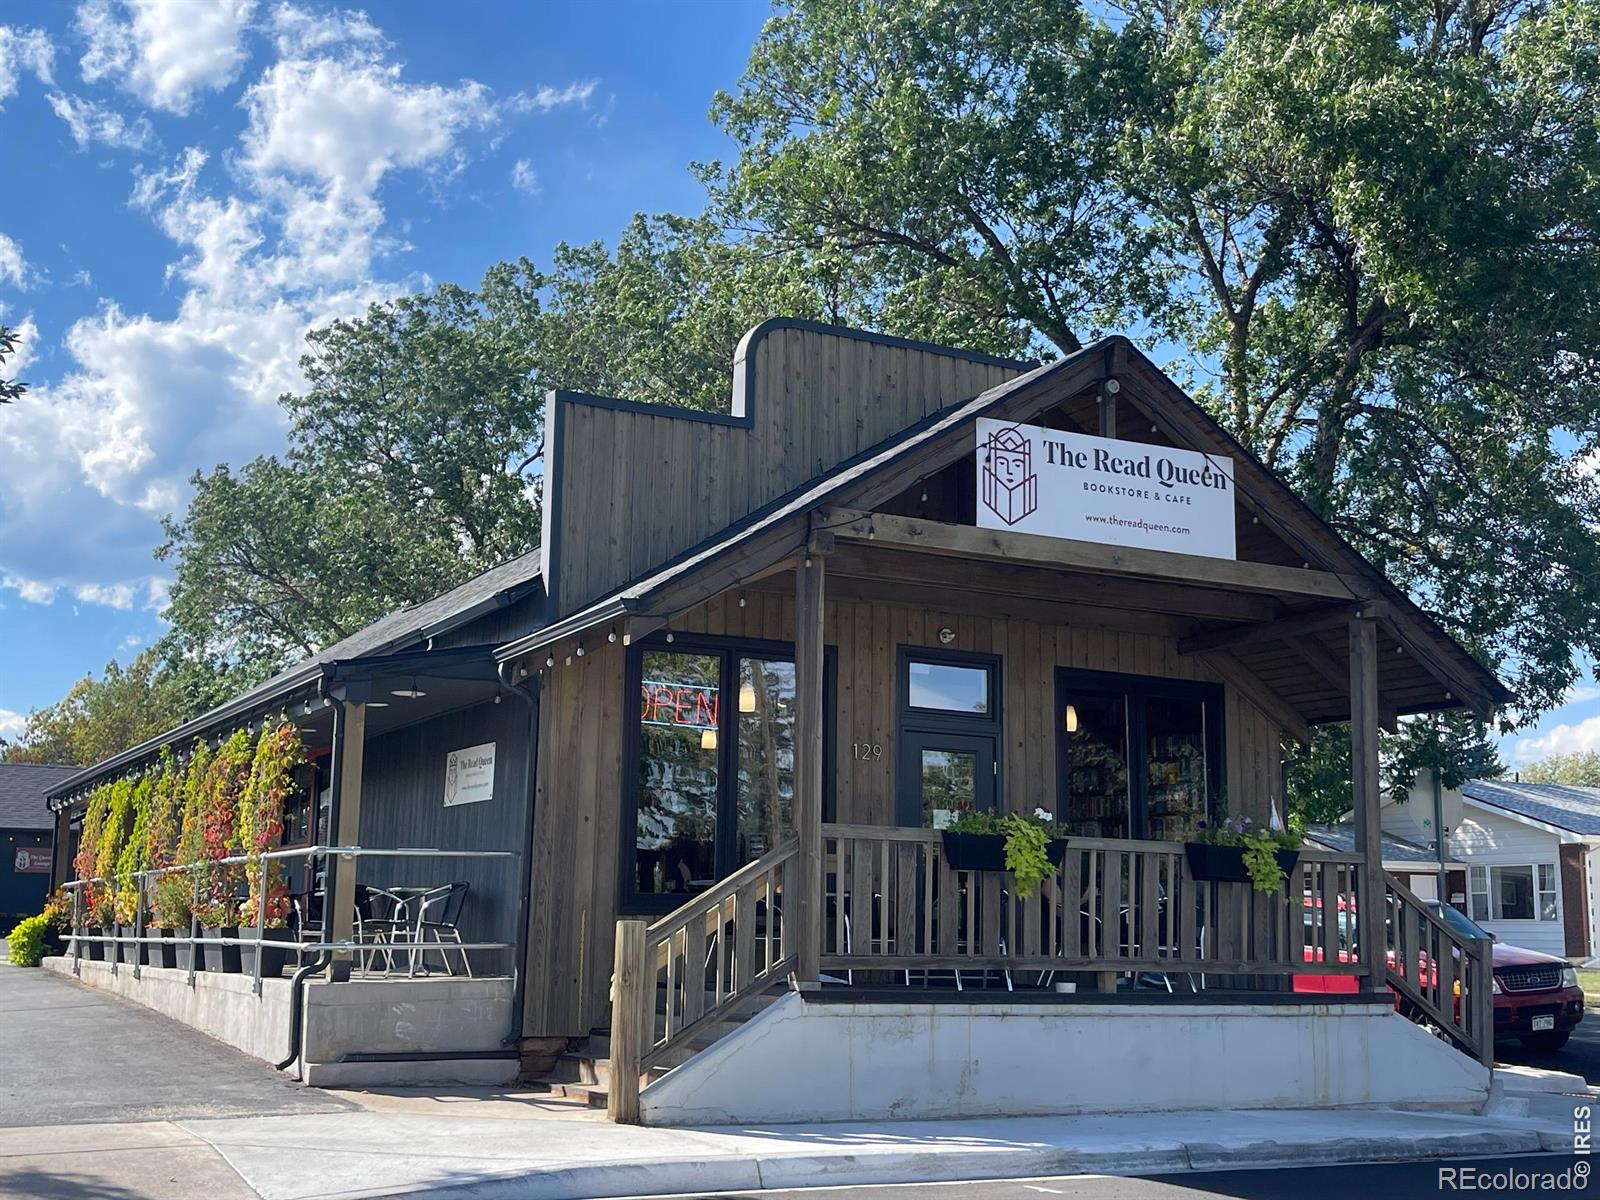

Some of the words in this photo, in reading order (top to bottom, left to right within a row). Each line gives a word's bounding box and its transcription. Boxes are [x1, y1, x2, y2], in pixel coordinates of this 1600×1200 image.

[1043, 440, 1088, 469] The
[1093, 448, 1151, 479] Read
[1156, 458, 1227, 490] Queen
[1083, 482, 1149, 499] BOOKSTORE
[1154, 492, 1161, 501] &
[1165, 494, 1192, 505] CAFE
[1085, 515, 1190, 535] www.thereadqueen.com
[853, 743, 883, 761] 129
